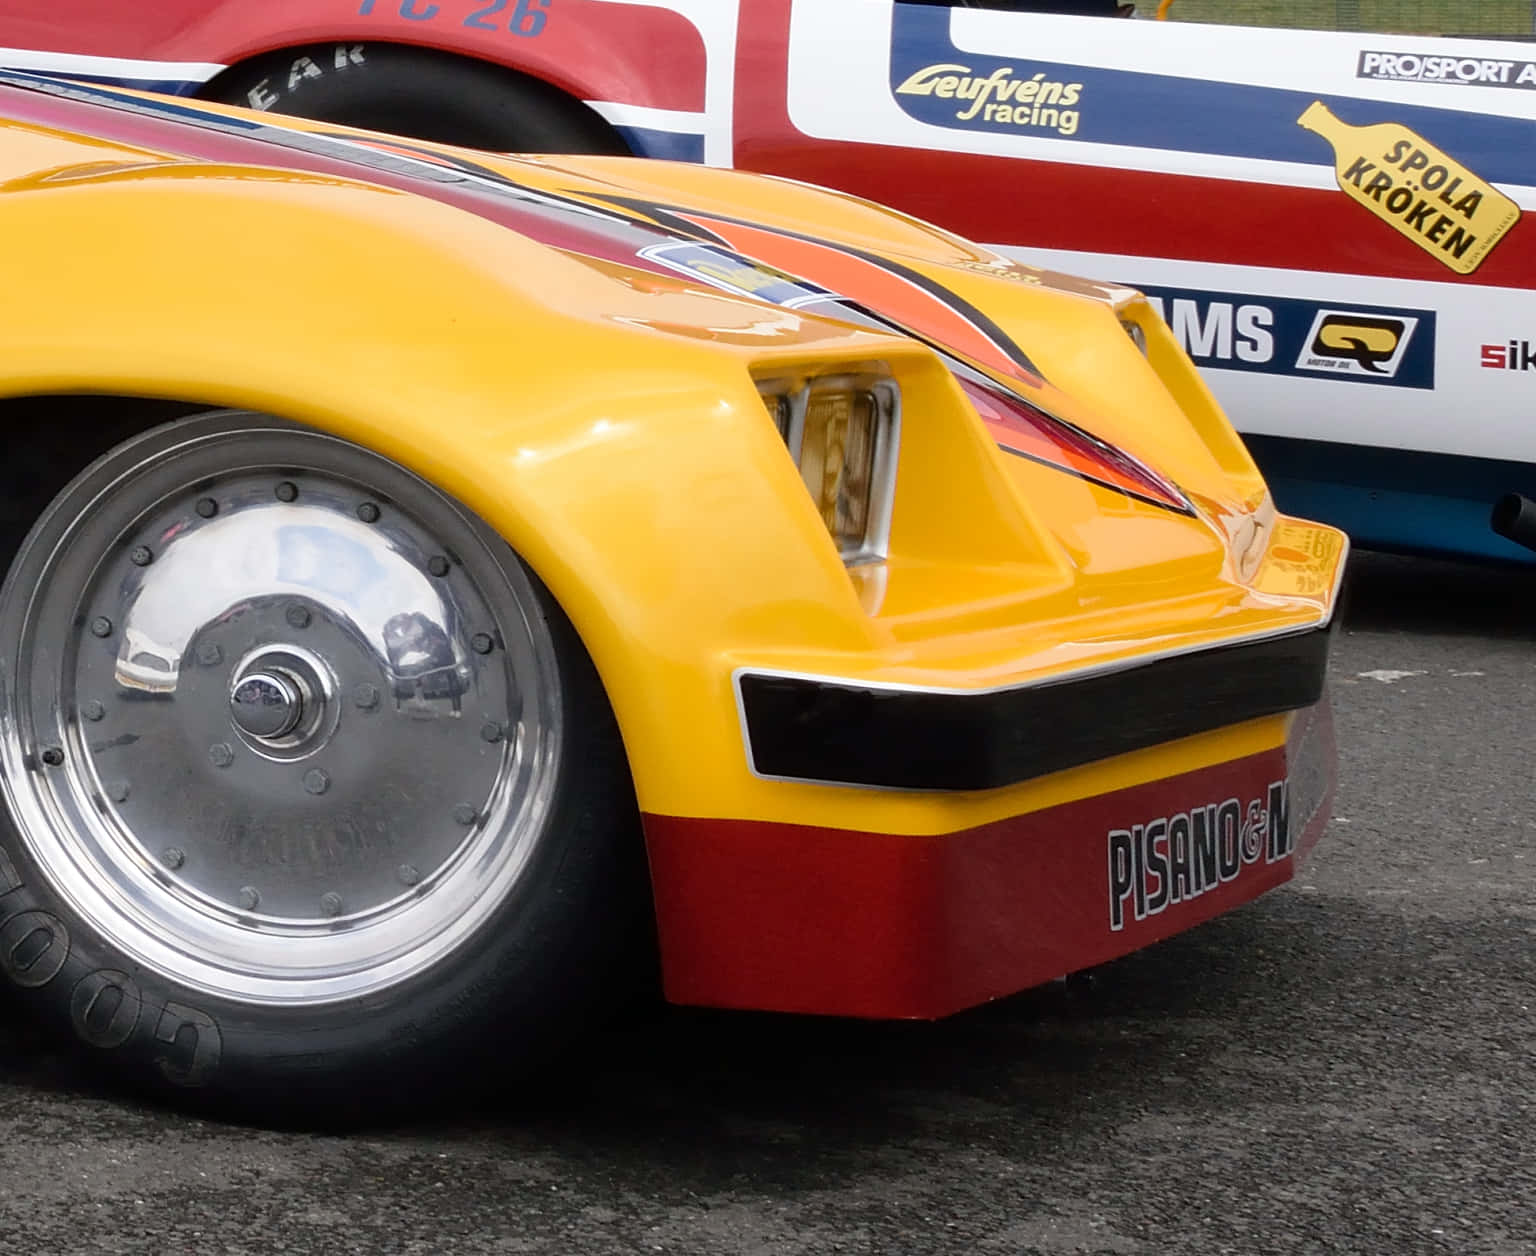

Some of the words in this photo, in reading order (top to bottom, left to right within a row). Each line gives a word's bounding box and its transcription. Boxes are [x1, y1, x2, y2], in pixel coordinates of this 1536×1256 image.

[896, 64, 1083, 120] Leufvéns
[983, 104, 1080, 135] racing
[1343, 156, 1477, 260] KRÖKEN
[1383, 140, 1484, 220] SPOLA
[1307, 358, 1336, 368] MOTOR
[1108, 798, 1241, 932] PISANO
